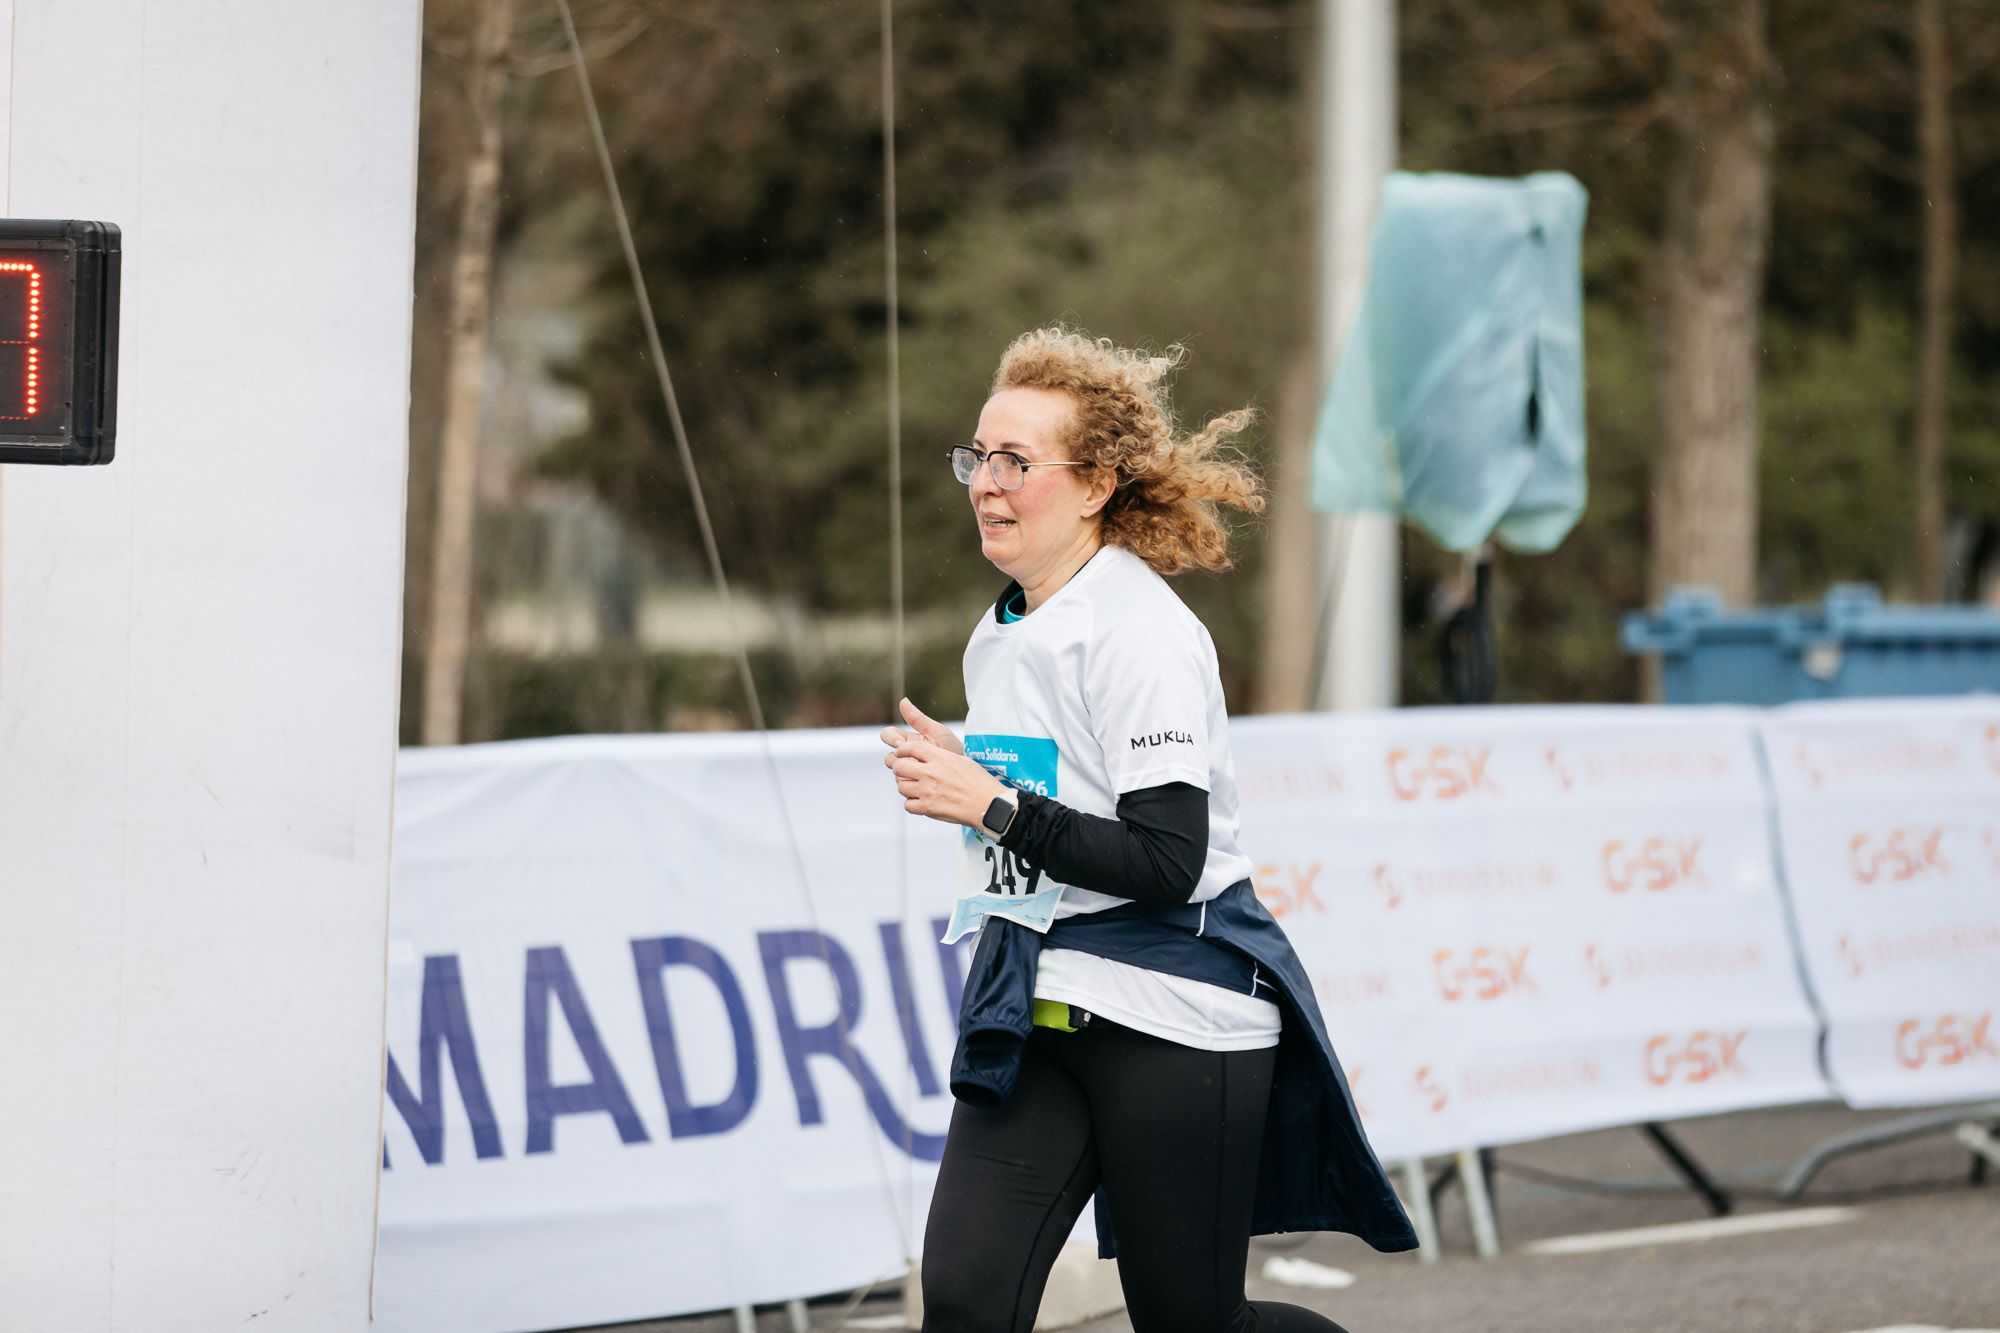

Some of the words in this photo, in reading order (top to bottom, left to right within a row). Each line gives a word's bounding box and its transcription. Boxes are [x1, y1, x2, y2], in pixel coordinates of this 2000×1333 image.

[985, 747, 1019, 763] Solidaria
[1130, 730, 1194, 750] MUKUA
[1386, 746, 1500, 801] GSK
[984, 846, 1041, 895] 249
[1253, 862, 1325, 918] SK
[1602, 836, 1706, 893] GSK
[1849, 824, 1951, 884] GSK
[1432, 946, 1541, 1000] GSK
[383, 916, 975, 1170] MADRI
[1644, 1030, 1748, 1086] GSK
